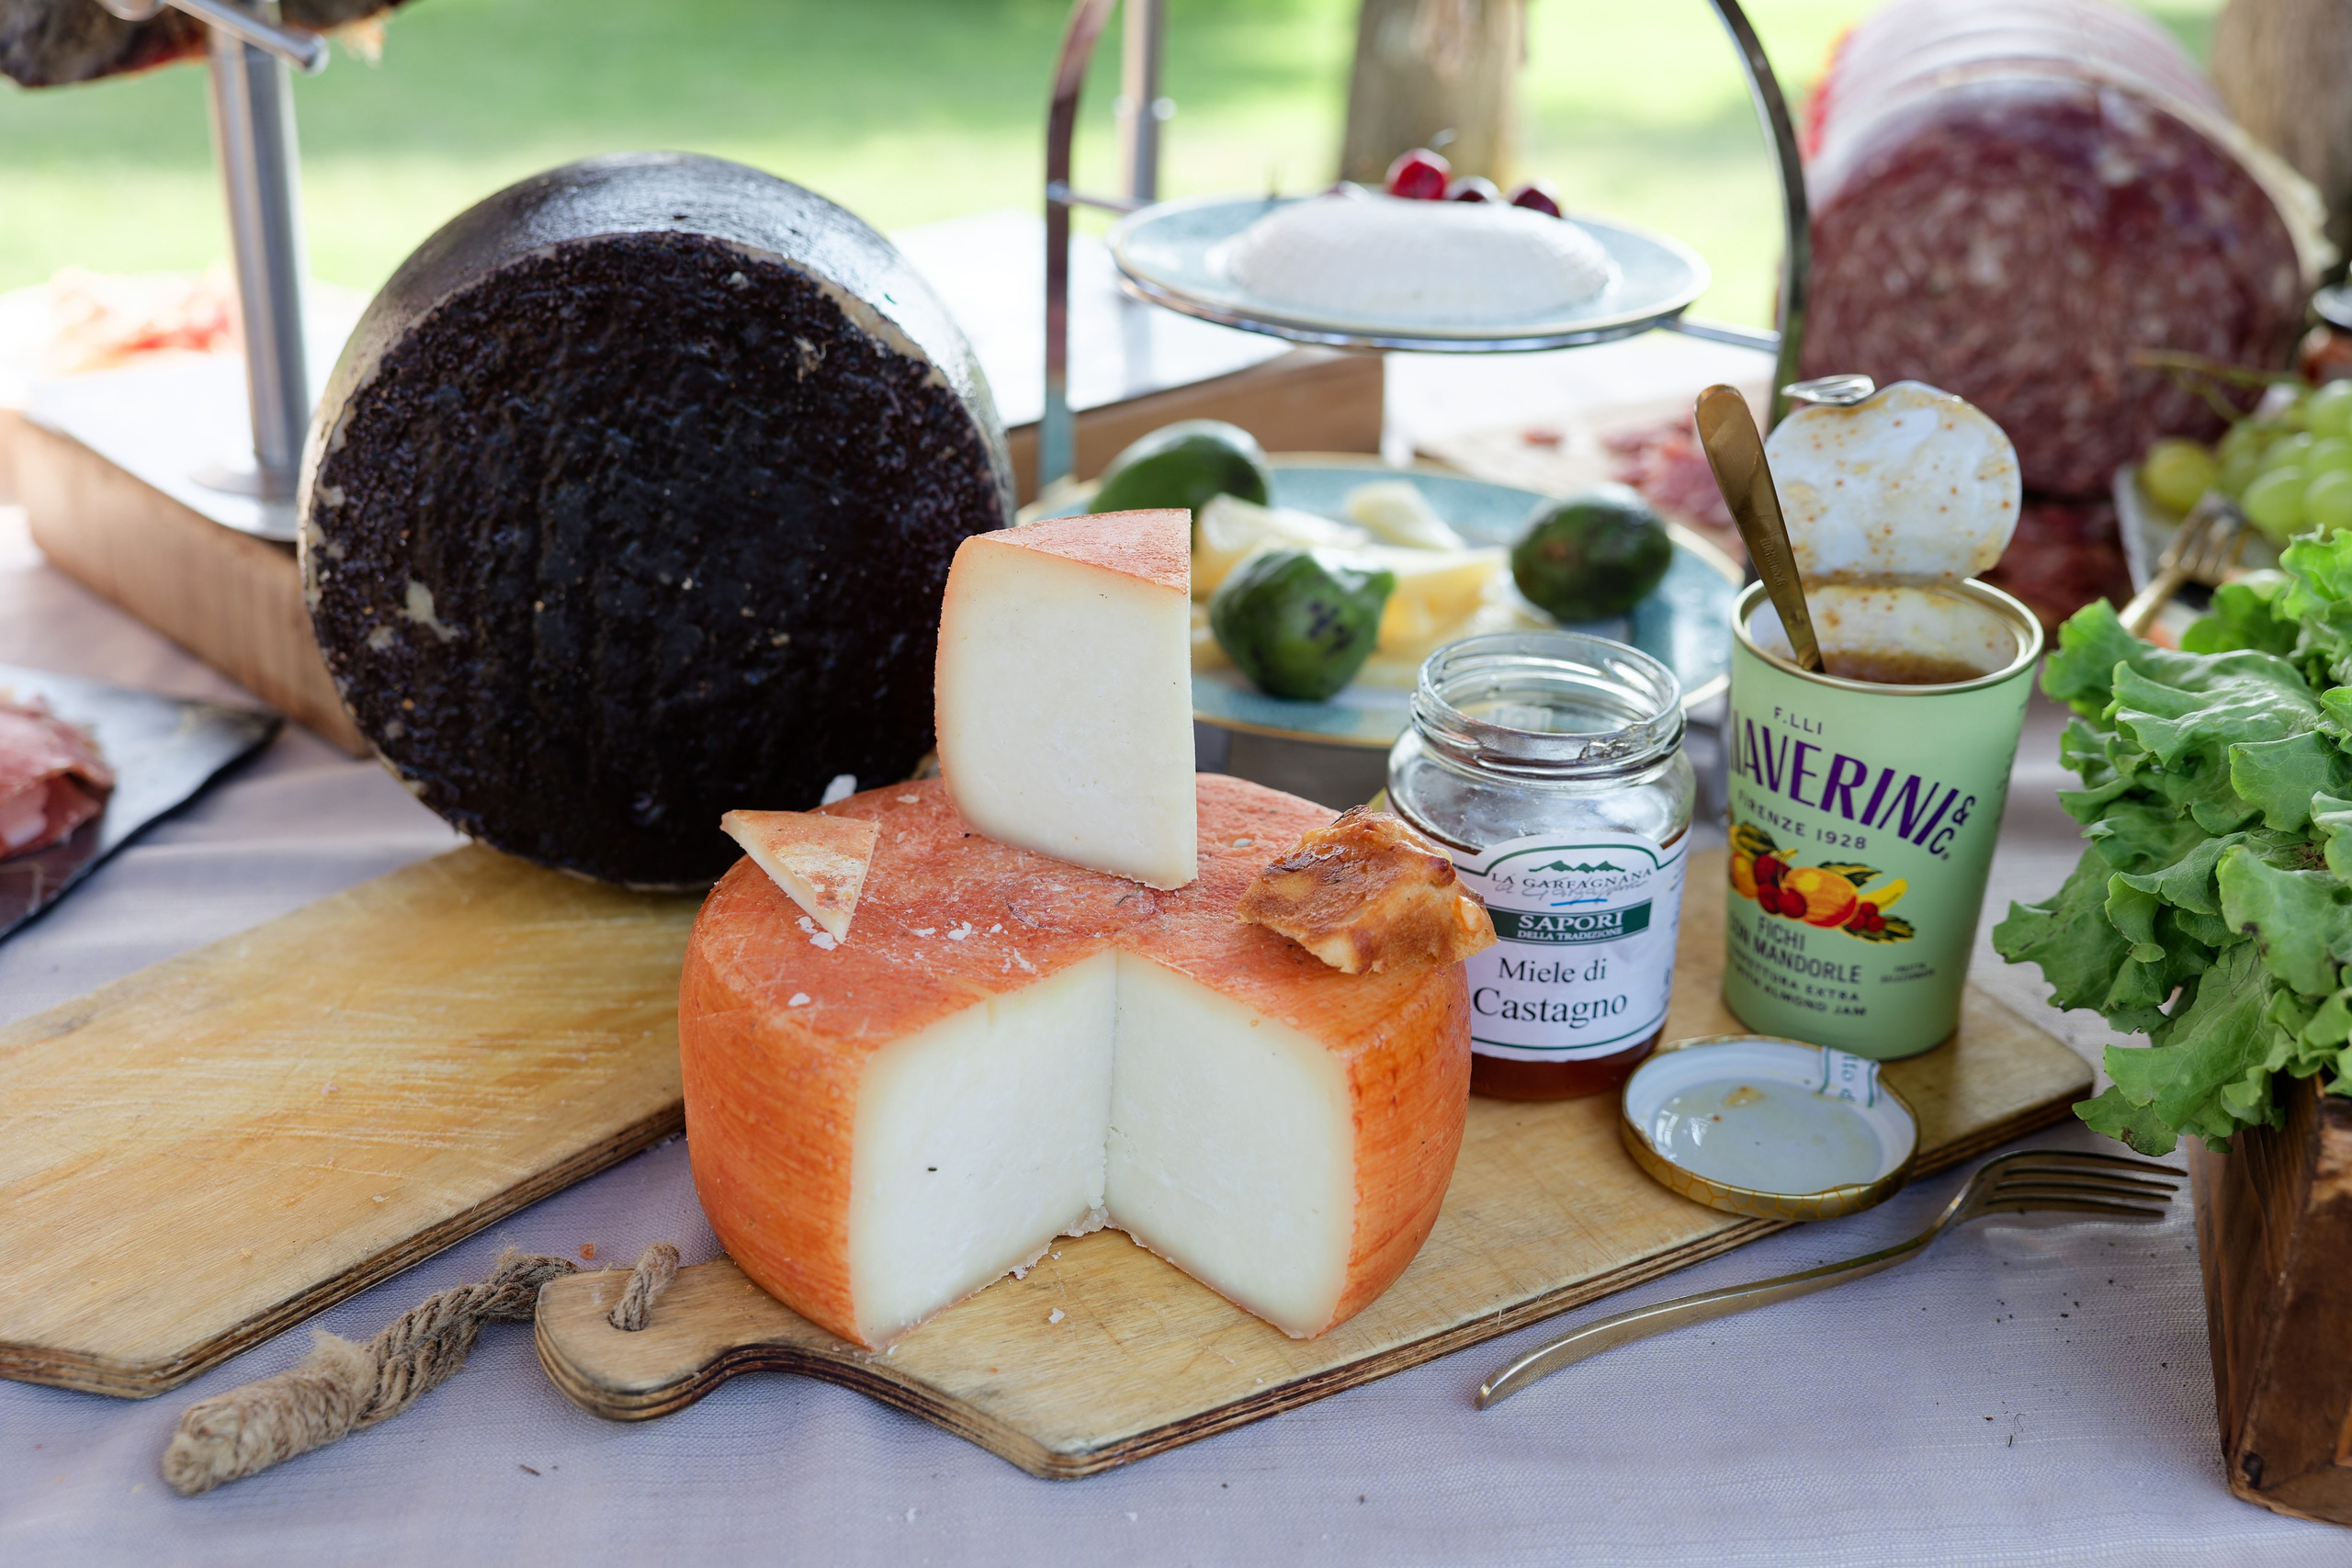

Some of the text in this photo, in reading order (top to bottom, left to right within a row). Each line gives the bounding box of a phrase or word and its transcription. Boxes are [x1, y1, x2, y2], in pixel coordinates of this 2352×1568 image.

[1774, 706, 1822, 735] F.LLI
[1730, 710, 1960, 847] IAVERINI
[1738, 789, 1868, 850] FIRENZE 1928
[1492, 873, 1515, 884] LA
[1523, 868, 1652, 889] GARFAGNANA
[1517, 926, 1624, 942] DELLA TRADIZIONE
[1518, 911, 1624, 931] SAPORI
[1758, 916, 1806, 951] FICHI
[1498, 957, 1607, 983] Miele di
[1473, 987, 1628, 1029] Castagno
